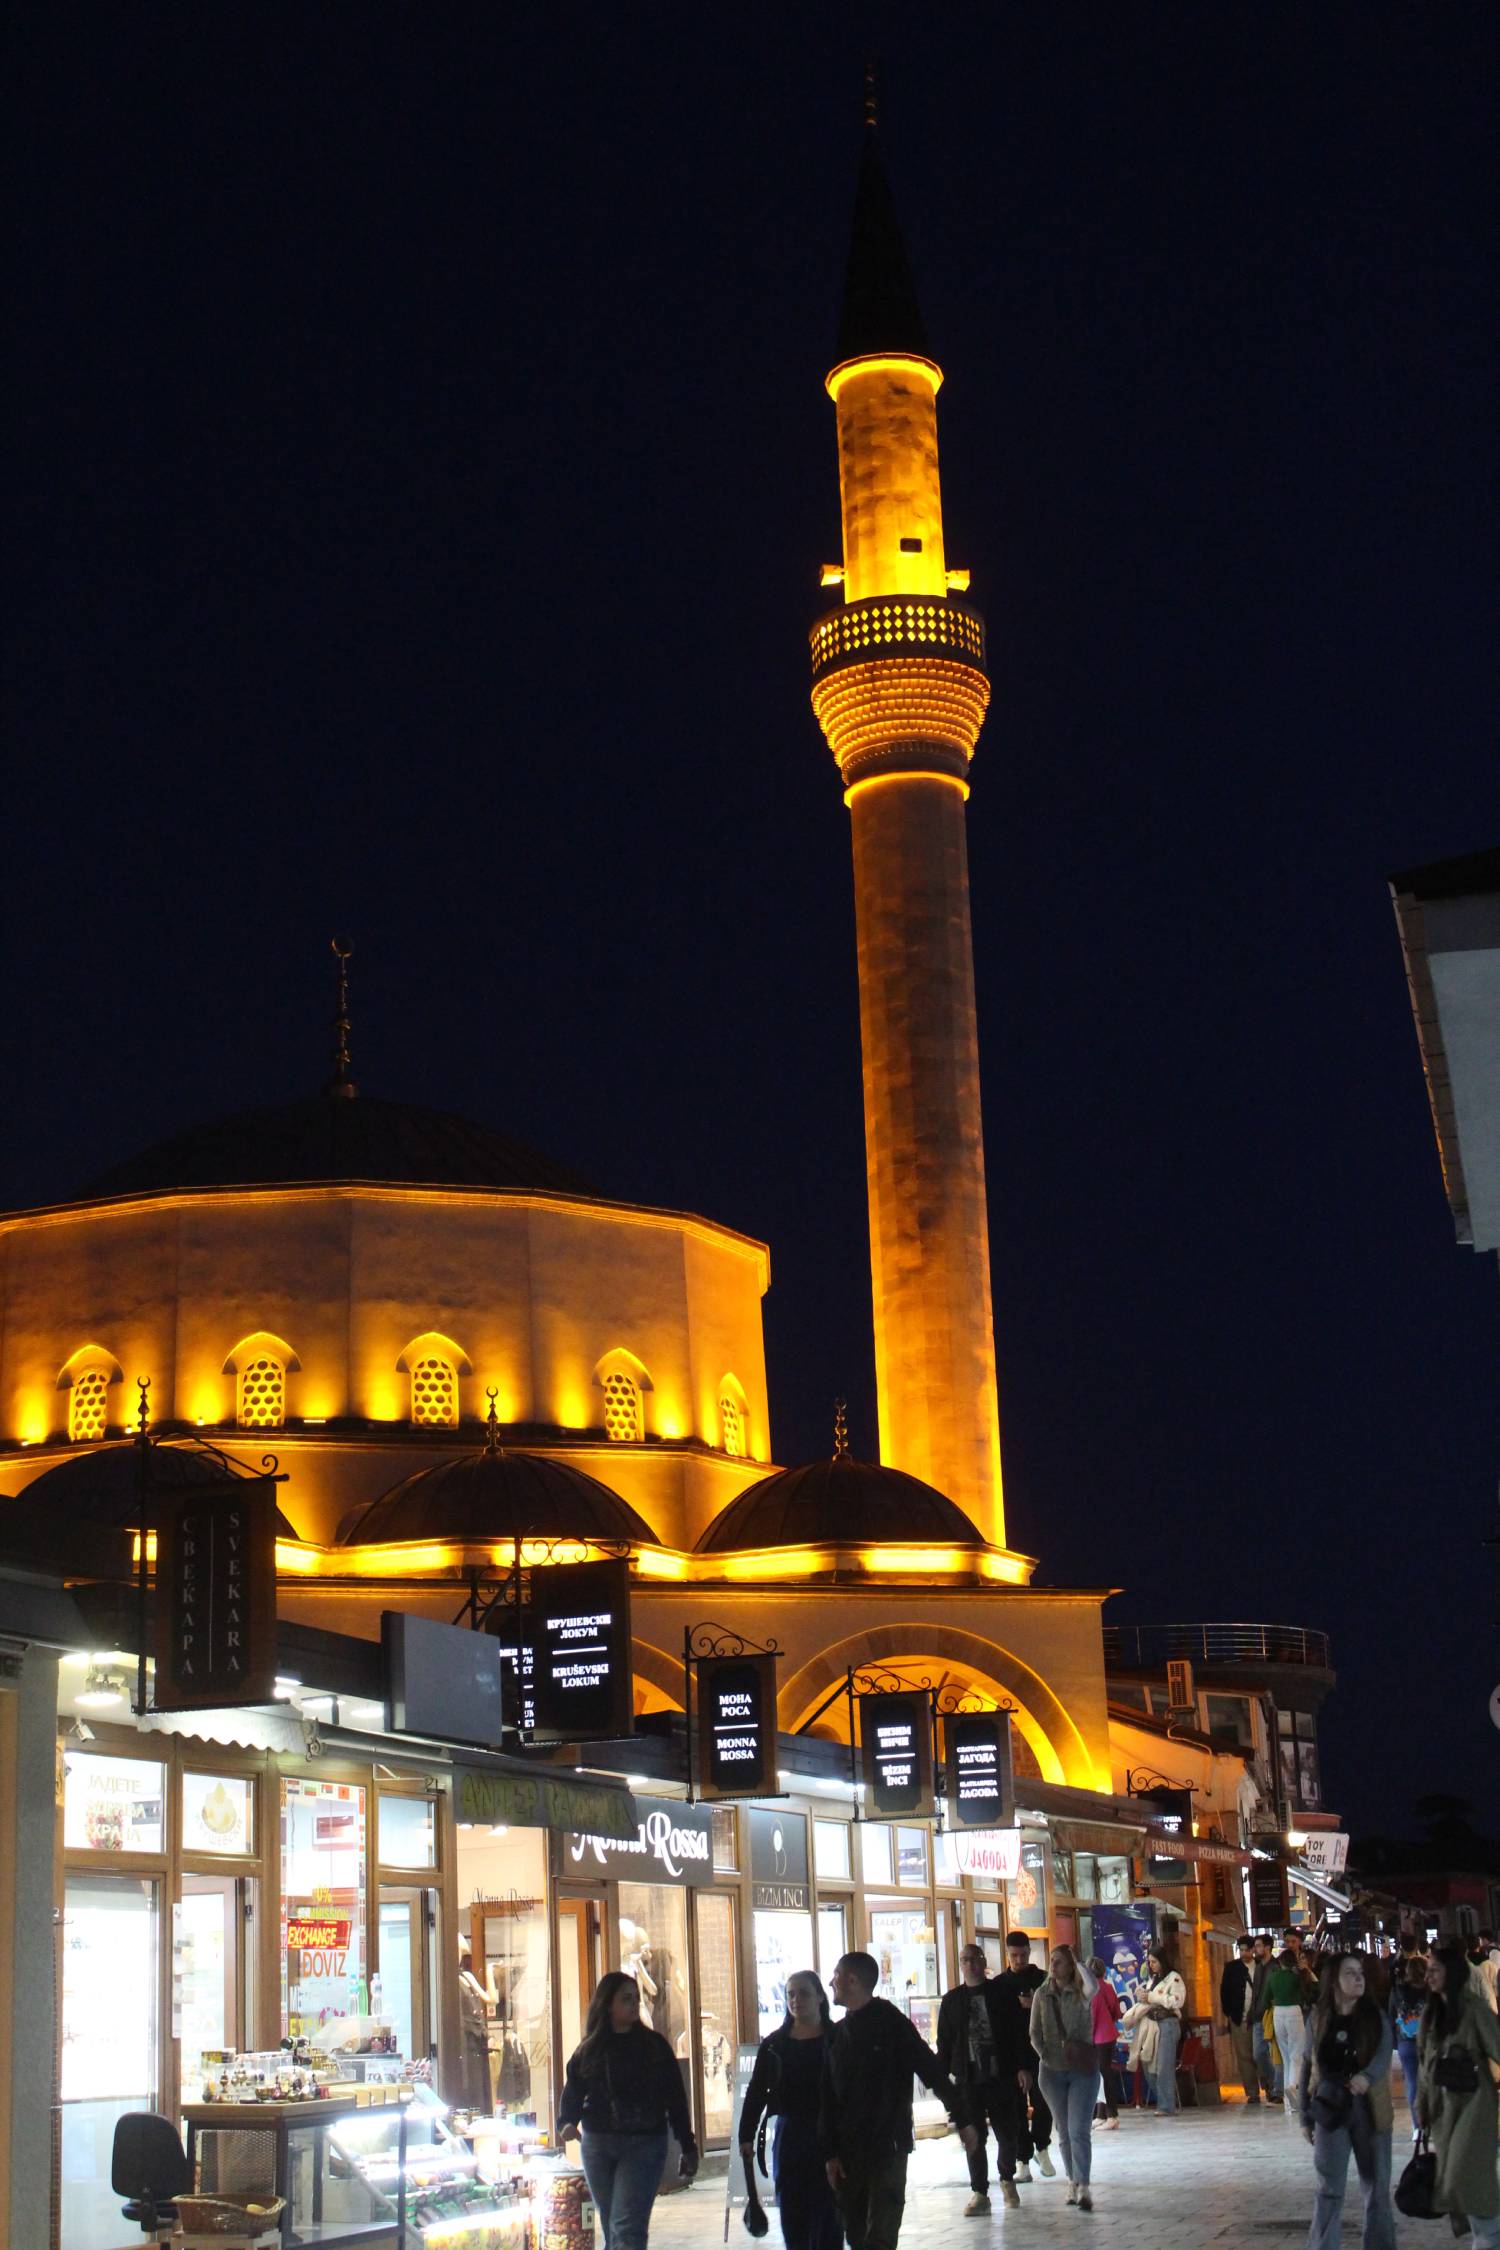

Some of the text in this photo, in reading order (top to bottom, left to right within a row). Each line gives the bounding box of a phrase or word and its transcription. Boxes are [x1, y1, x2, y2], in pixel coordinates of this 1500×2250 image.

[227, 1512, 241, 1671] SVEKARA
[547, 1614, 611, 1630] КРУШЕВСКИ
[560, 1627, 598, 1639] ЛОКУМ
[552, 1664, 609, 1678] KRUŠEVSKI
[562, 1676, 600, 1688] LOKUM
[719, 1694, 752, 1705] МОНА
[721, 1706, 750, 1717] РОСА
[717, 1737, 757, 1749] MONNA
[720, 1749, 754, 1761] ROSSA
[959, 1788, 999, 1798] JAGODA
[646, 1811, 709, 1877] Rossa
[1151, 1840, 1167, 1854] FAST
[1168, 1842, 1185, 1856] FOOD
[1198, 1846, 1216, 1859] PIZZA
[1308, 1840, 1324, 1851] TOY
[970, 1848, 1008, 1871] JAGODA
[287, 1926, 337, 1946] EXCHANGE
